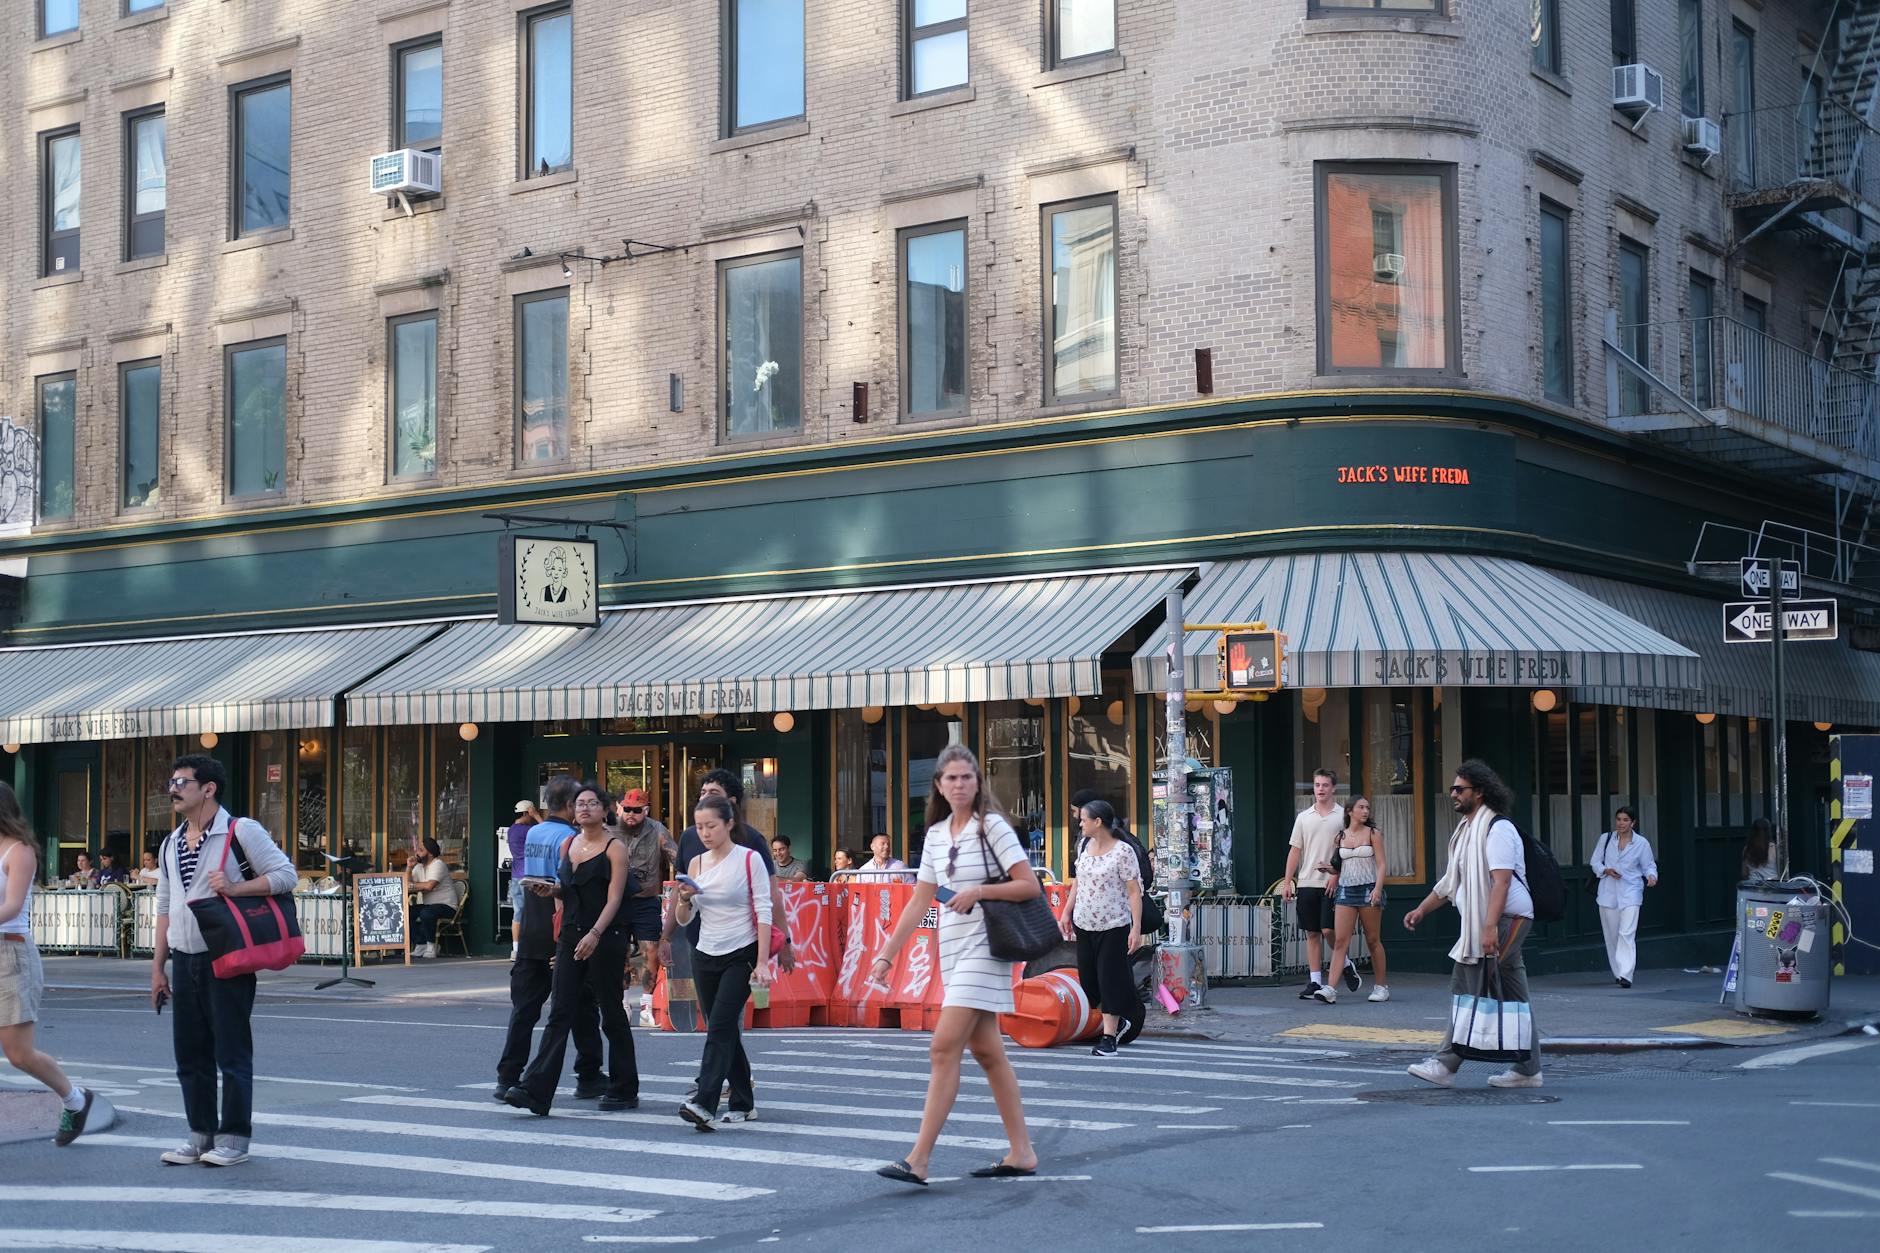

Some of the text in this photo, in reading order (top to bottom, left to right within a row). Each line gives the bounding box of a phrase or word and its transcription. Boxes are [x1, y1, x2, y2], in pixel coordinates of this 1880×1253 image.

[1338, 465, 1469, 485] JACK'S WIFE FREDA
[1749, 571, 1794, 587] ONE AY
[1741, 612, 1821, 630] ONE WAY
[1375, 655, 1572, 679] JACK'S WIFE FREDA
[619, 691, 664, 712] JACK'S
[710, 688, 753, 709] FREDA
[50, 717, 143, 738] JACK'S WIFE FREDA
